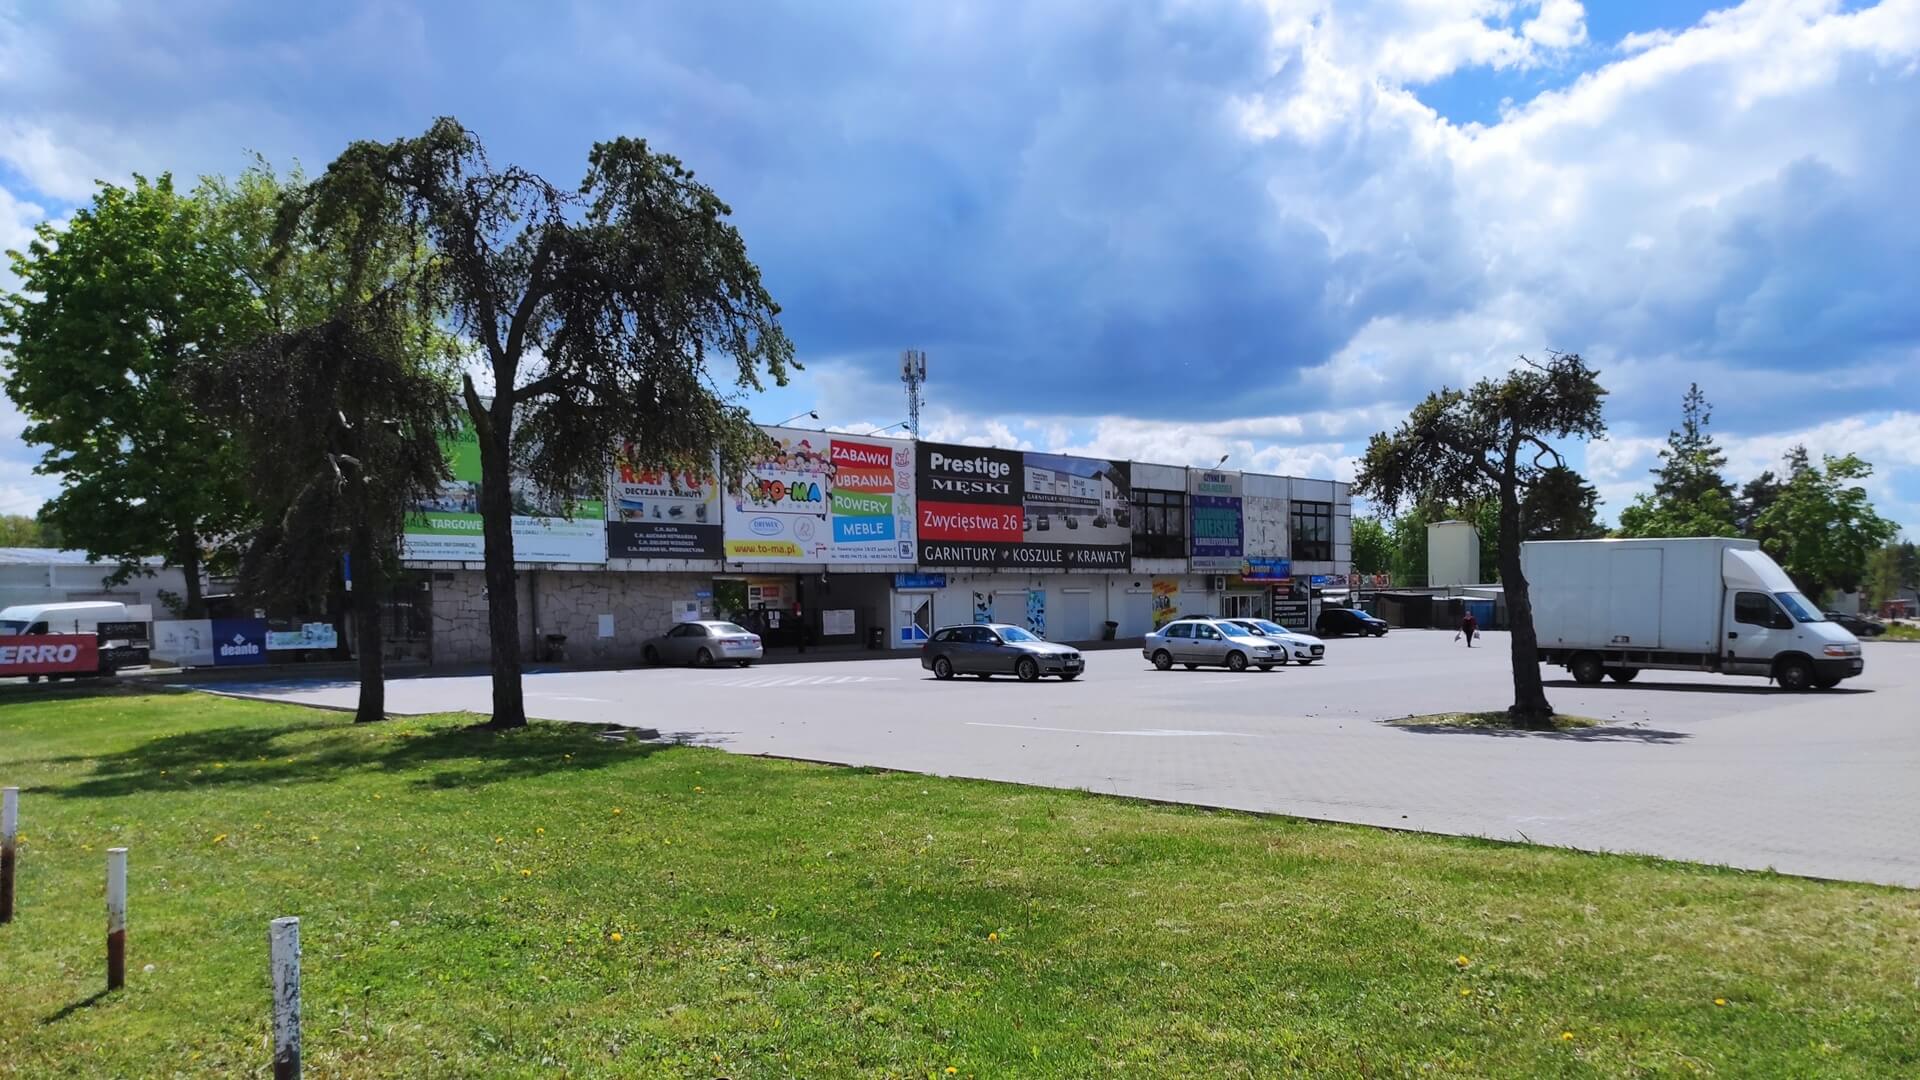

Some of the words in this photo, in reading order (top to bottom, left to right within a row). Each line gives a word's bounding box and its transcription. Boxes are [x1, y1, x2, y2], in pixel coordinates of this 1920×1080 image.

[832, 446, 889, 466] ZABAWKI
[930, 452, 1010, 479] Prestige
[835, 474, 893, 487] UBRANIA
[931, 478, 1009, 496] MĘSKI
[625, 487, 658, 496] DECYZJA
[834, 495, 888, 514] ROWERY
[431, 519, 483, 530] TARGOWE
[843, 522, 884, 536] MEBLE
[923, 510, 999, 532] Zwycięstwa
[1002, 514, 1018, 531] 26
[734, 544, 796, 556] www.to-ma.pl
[924, 546, 996, 561] GARNITURY
[1012, 548, 1063, 563] KOSZULE
[1077, 550, 1126, 564] KRAWATY
[220, 643, 259, 656] deante
